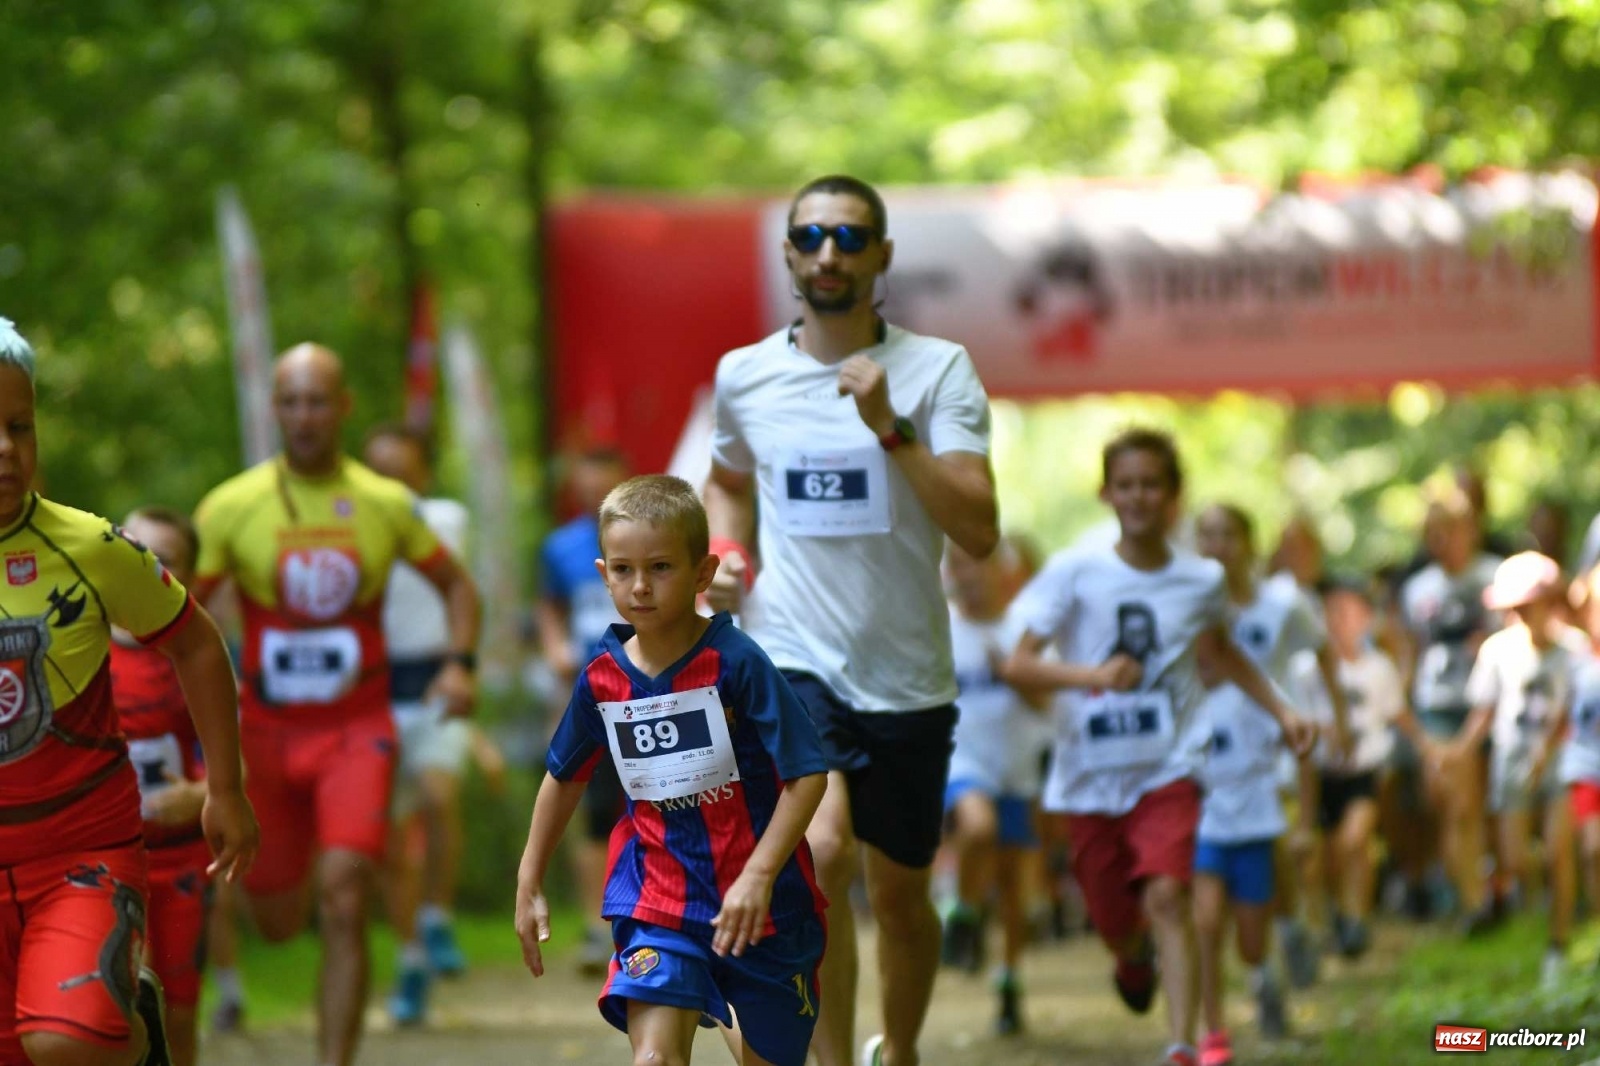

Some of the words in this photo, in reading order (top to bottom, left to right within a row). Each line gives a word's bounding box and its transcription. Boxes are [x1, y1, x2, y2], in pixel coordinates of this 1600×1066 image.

[804, 473, 844, 498] 62
[633, 720, 680, 753] 89
[698, 748, 715, 757] 11.00
